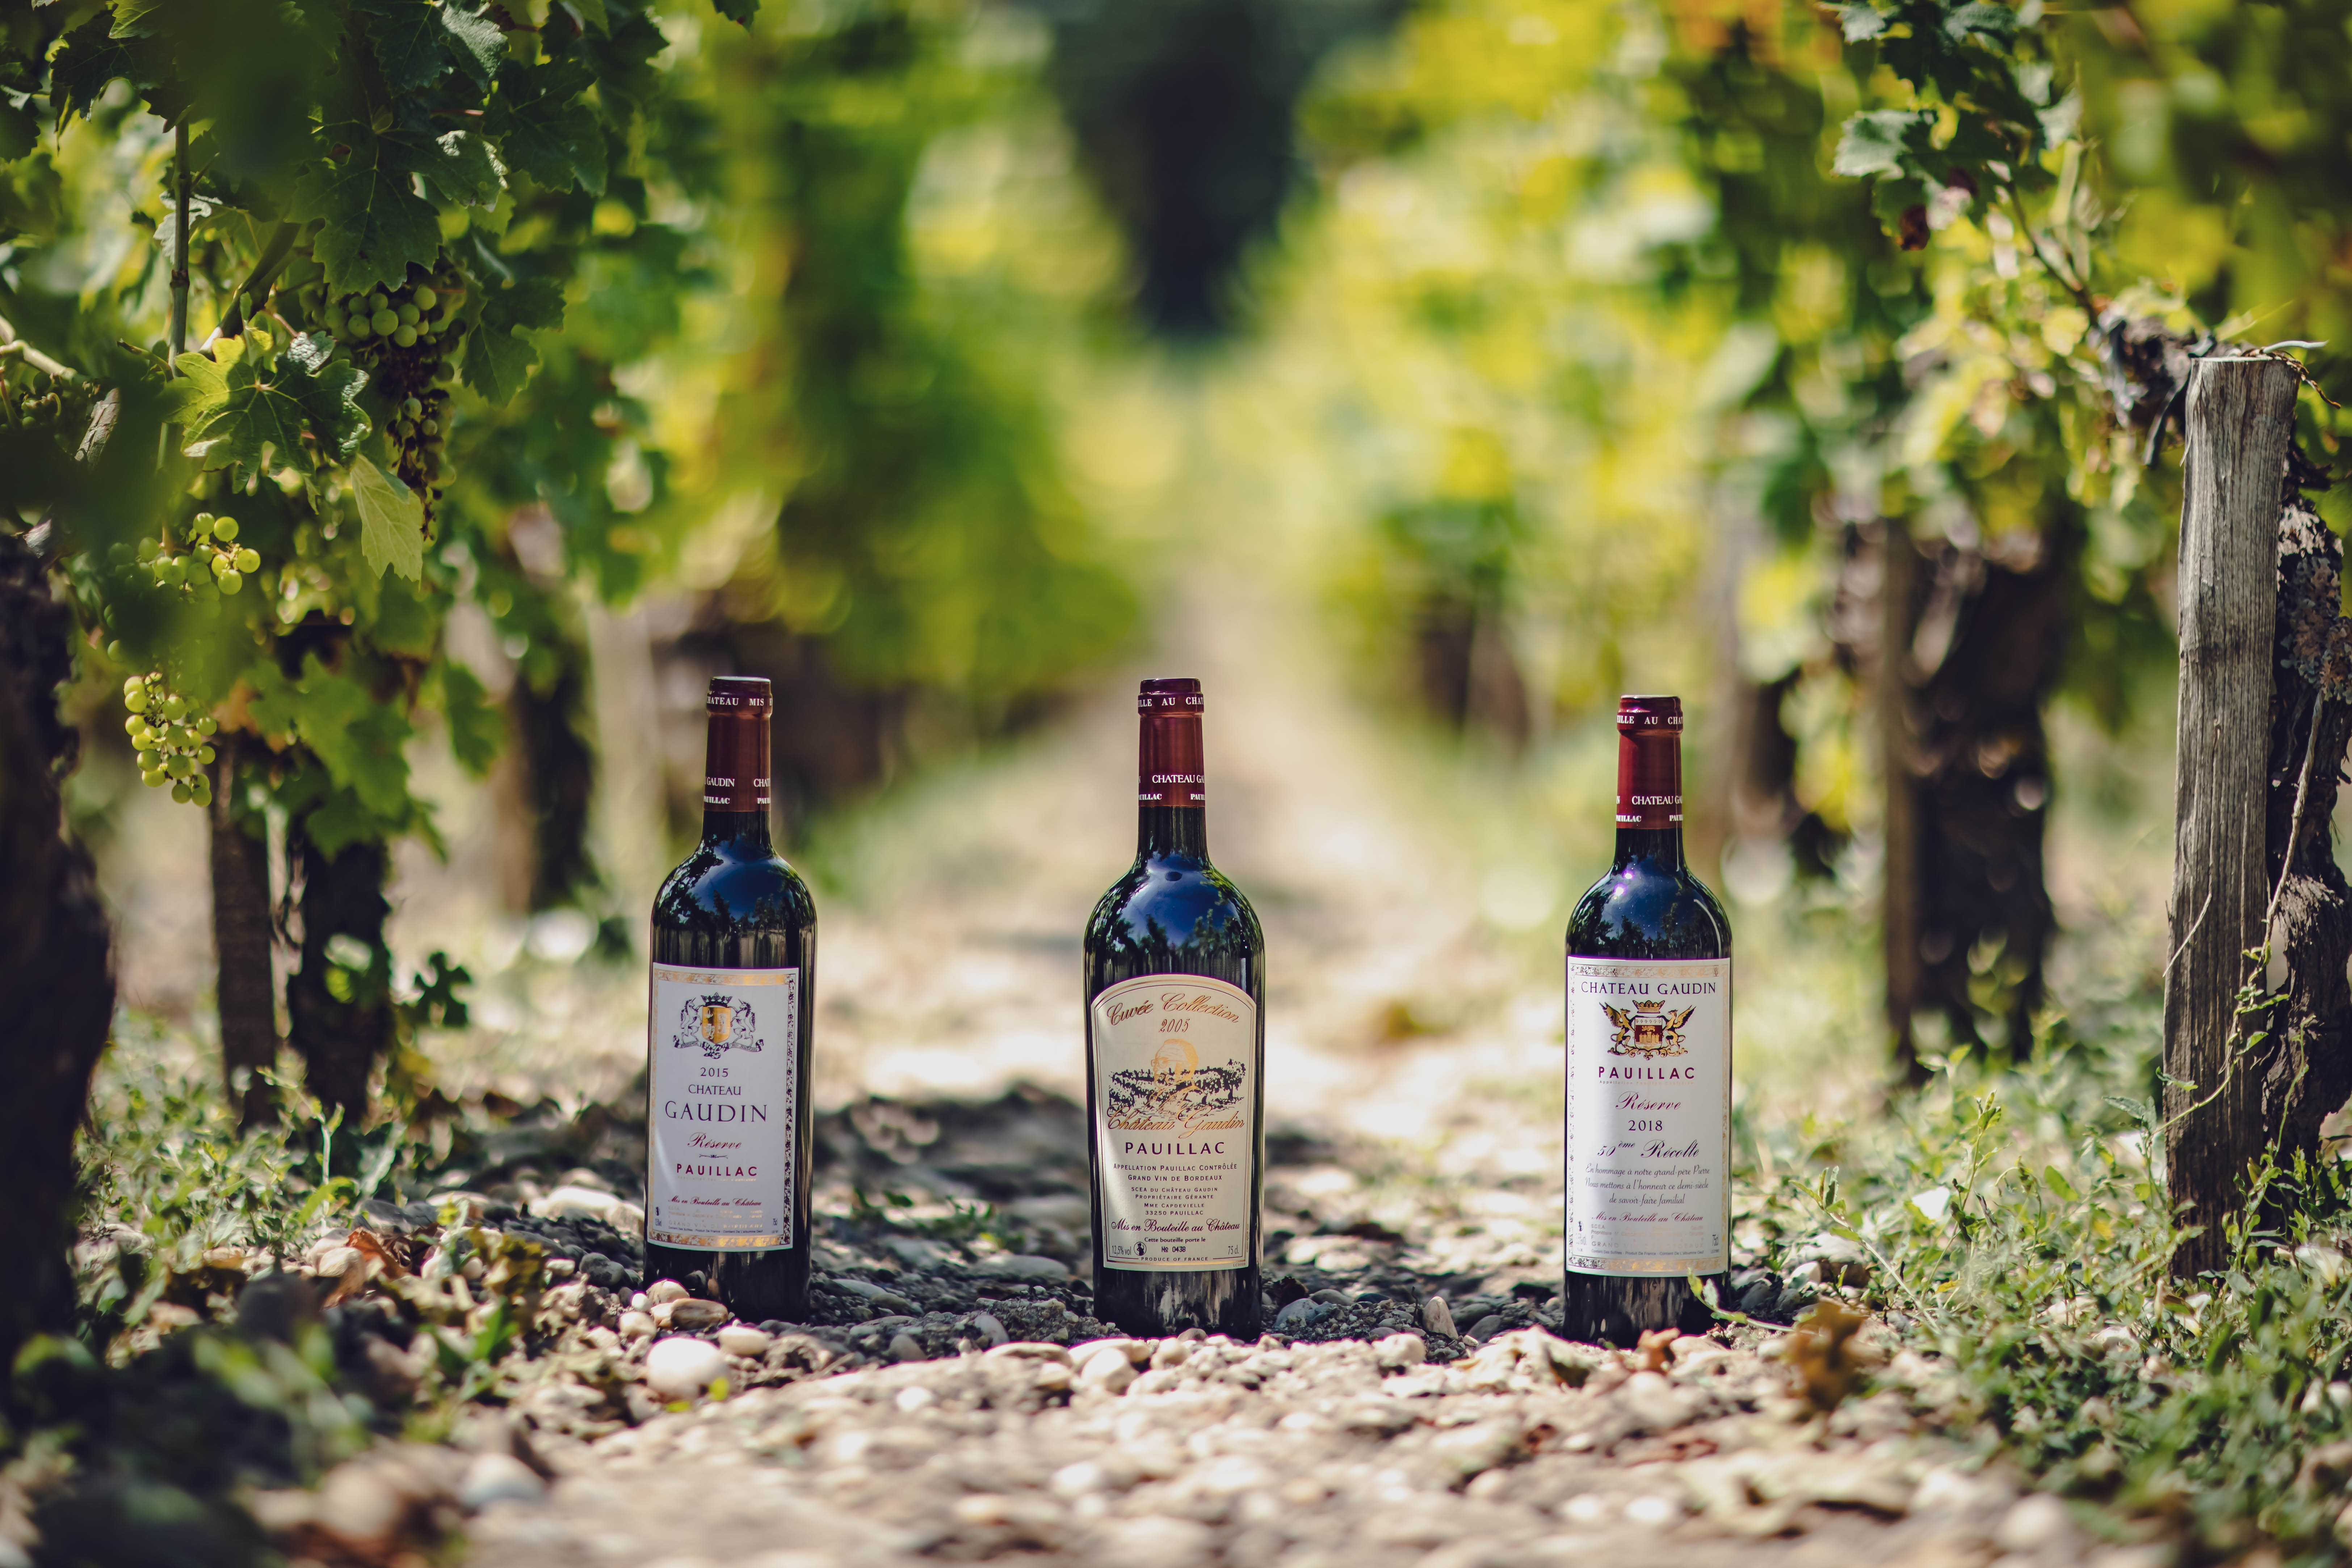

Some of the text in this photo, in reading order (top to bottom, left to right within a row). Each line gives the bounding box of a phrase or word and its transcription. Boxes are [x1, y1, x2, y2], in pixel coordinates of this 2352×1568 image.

[1162, 697, 1176, 706] AU
[707, 777, 735, 787] GAUDIN
[1152, 774, 1195, 783] CHATEAU
[1631, 795, 1673, 805] CHATEAU
[1581, 981, 1716, 995] CHATEAU GAUDIN
[1107, 992, 1239, 1026] Cuvée Collection
[1159, 1018, 1190, 1033] 2005
[700, 1067, 729, 1077] 2015
[1599, 1067, 1695, 1079] PAUILLAC
[688, 1084, 742, 1096] CHATEAU
[1615, 1091, 1681, 1110] Réserve
[665, 1101, 767, 1122] GAUDIN
[1106, 1104, 1244, 1139] Château Gaudin
[1628, 1120, 1663, 1131] 2018
[687, 1132, 742, 1149] Réserve
[1125, 1142, 1225, 1155] PAUILLAC
[1640, 1139, 1700, 1158] Récolte
[677, 1163, 757, 1176] PAUILLAC
[1585, 1163, 1594, 1173] En
[1595, 1163, 1625, 1177] hommage
[1654, 1165, 1691, 1178] grand-père
[1693, 1164, 1710, 1175] Pierre
[1585, 1177, 1599, 1188] Nous
[1677, 1178, 1709, 1190] demi-siècle
[668, 1194, 680, 1203] Mis
[1609, 1193, 1685, 1207] de savoir-faire familial
[1591, 1211, 1606, 1221] Mis
[1619, 1212, 1658, 1222] Bouteille
[1111, 1218, 1129, 1231] Mis
[1144, 1219, 1189, 1232] Bouteille
[1206, 1218, 1240, 1232] Château
[1228, 1246, 1234, 1255] 75
